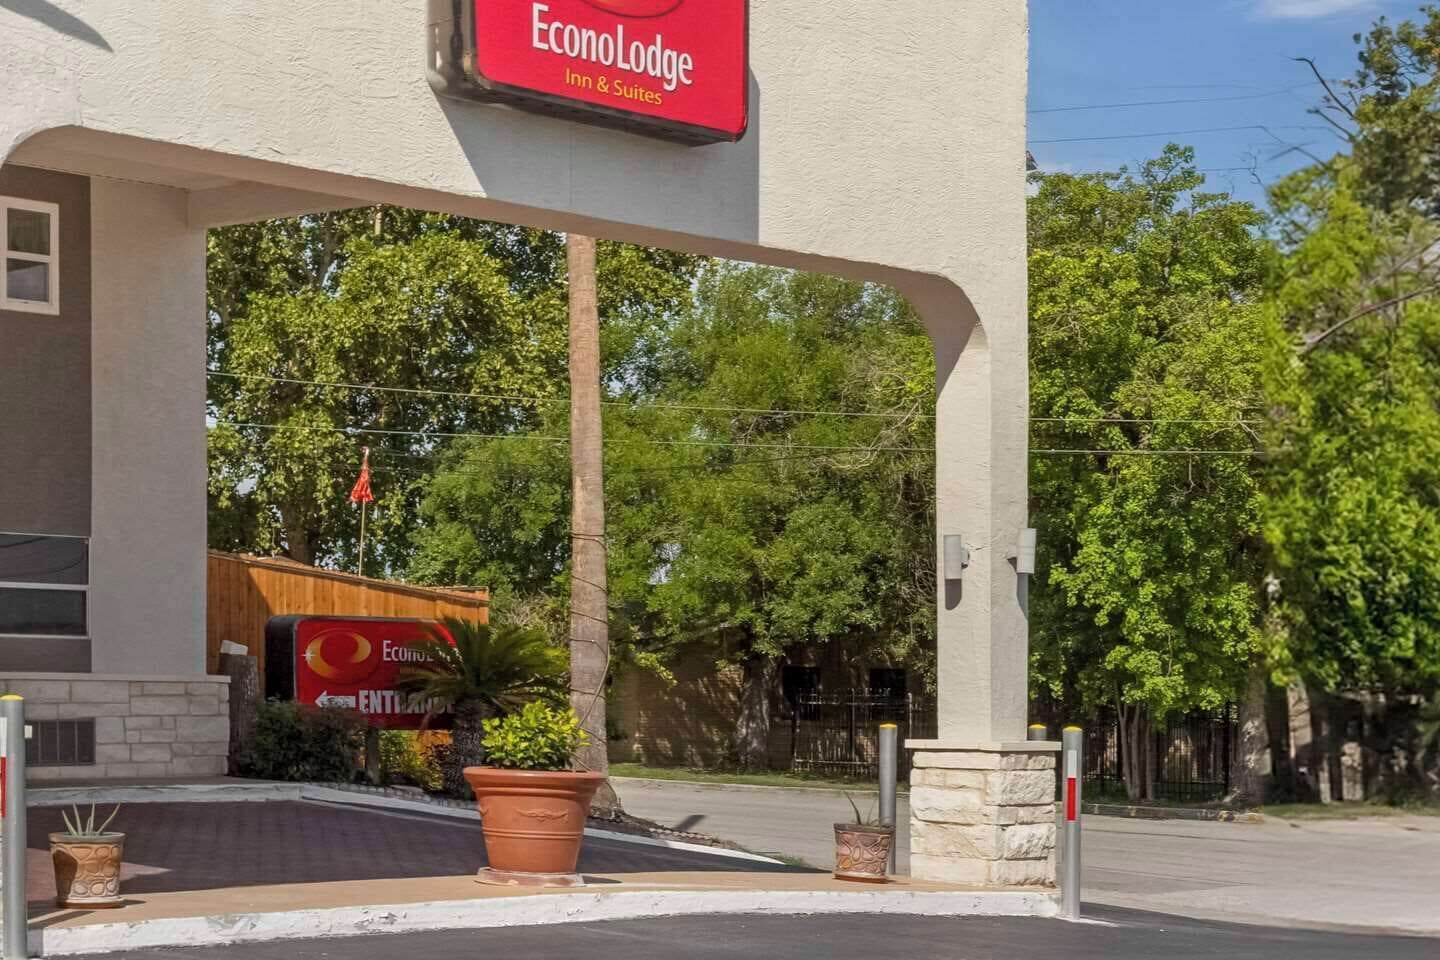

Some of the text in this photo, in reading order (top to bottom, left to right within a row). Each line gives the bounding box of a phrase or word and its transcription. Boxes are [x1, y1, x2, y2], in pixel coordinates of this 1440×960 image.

[532, 2, 693, 91] EconoLodge
[565, 67, 663, 105] Inn & Suites
